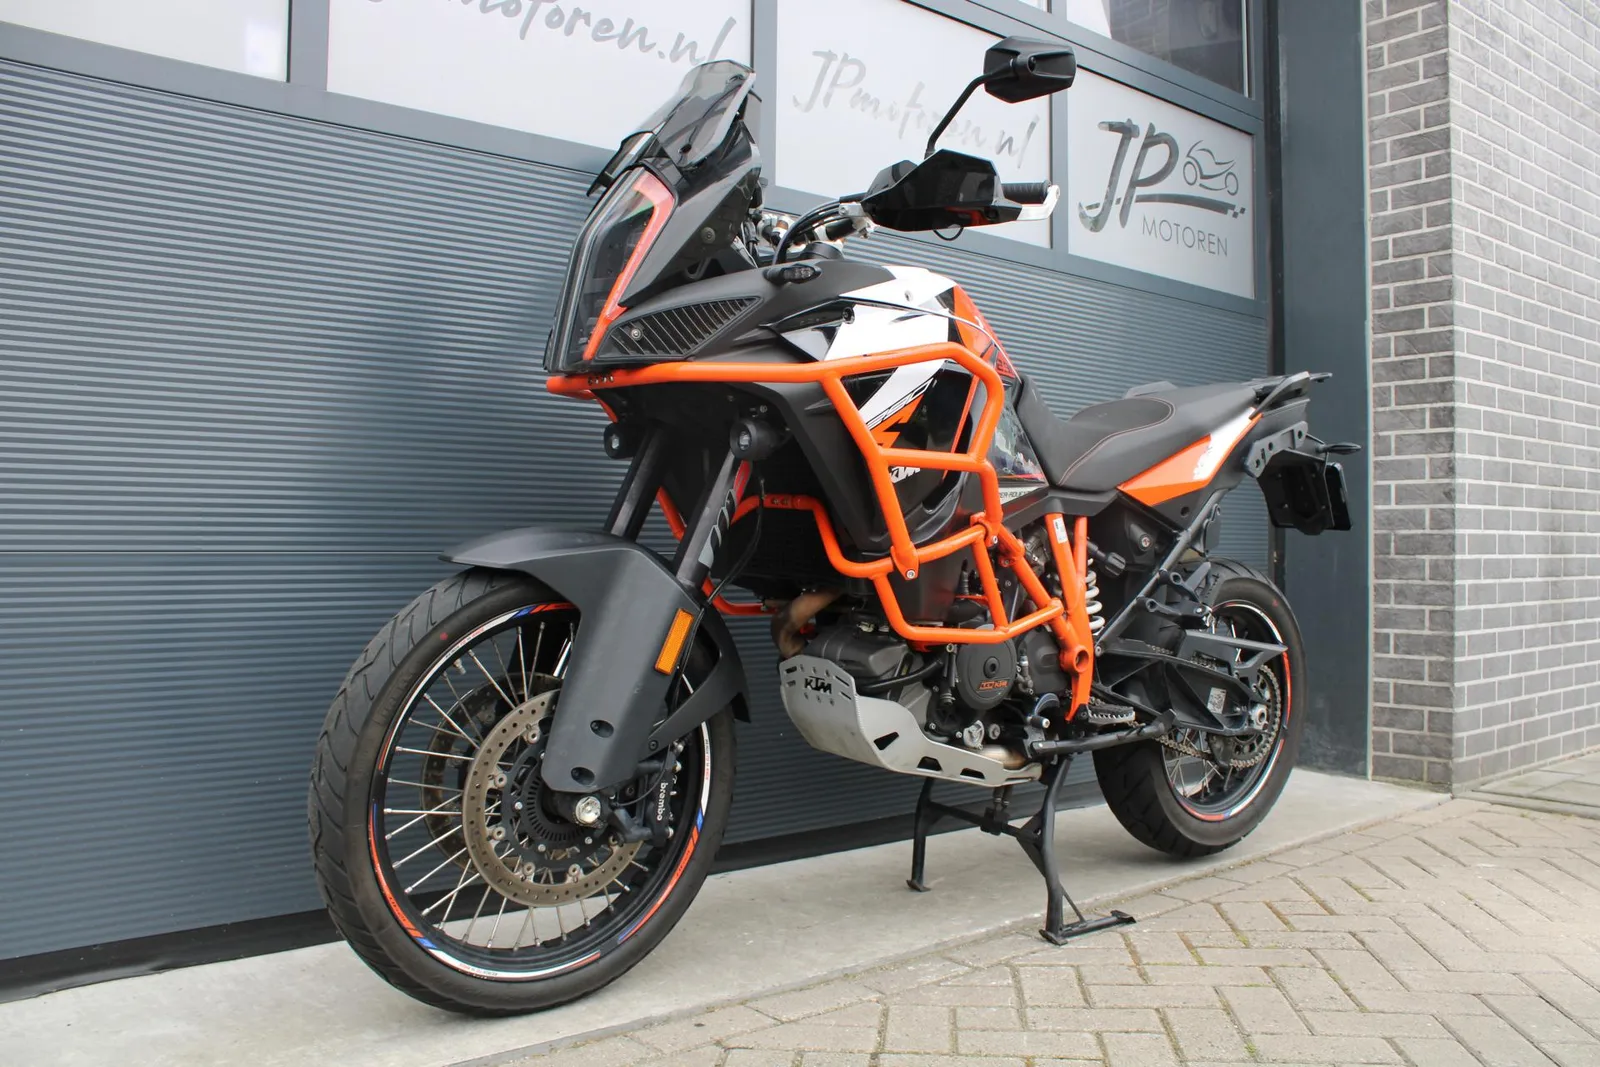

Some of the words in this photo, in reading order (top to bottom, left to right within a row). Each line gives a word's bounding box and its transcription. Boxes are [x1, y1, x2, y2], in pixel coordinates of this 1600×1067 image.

[1142, 215, 1228, 257] MOTOREN
[804, 676, 832, 694] KTM
[657, 782, 668, 820] brembo
